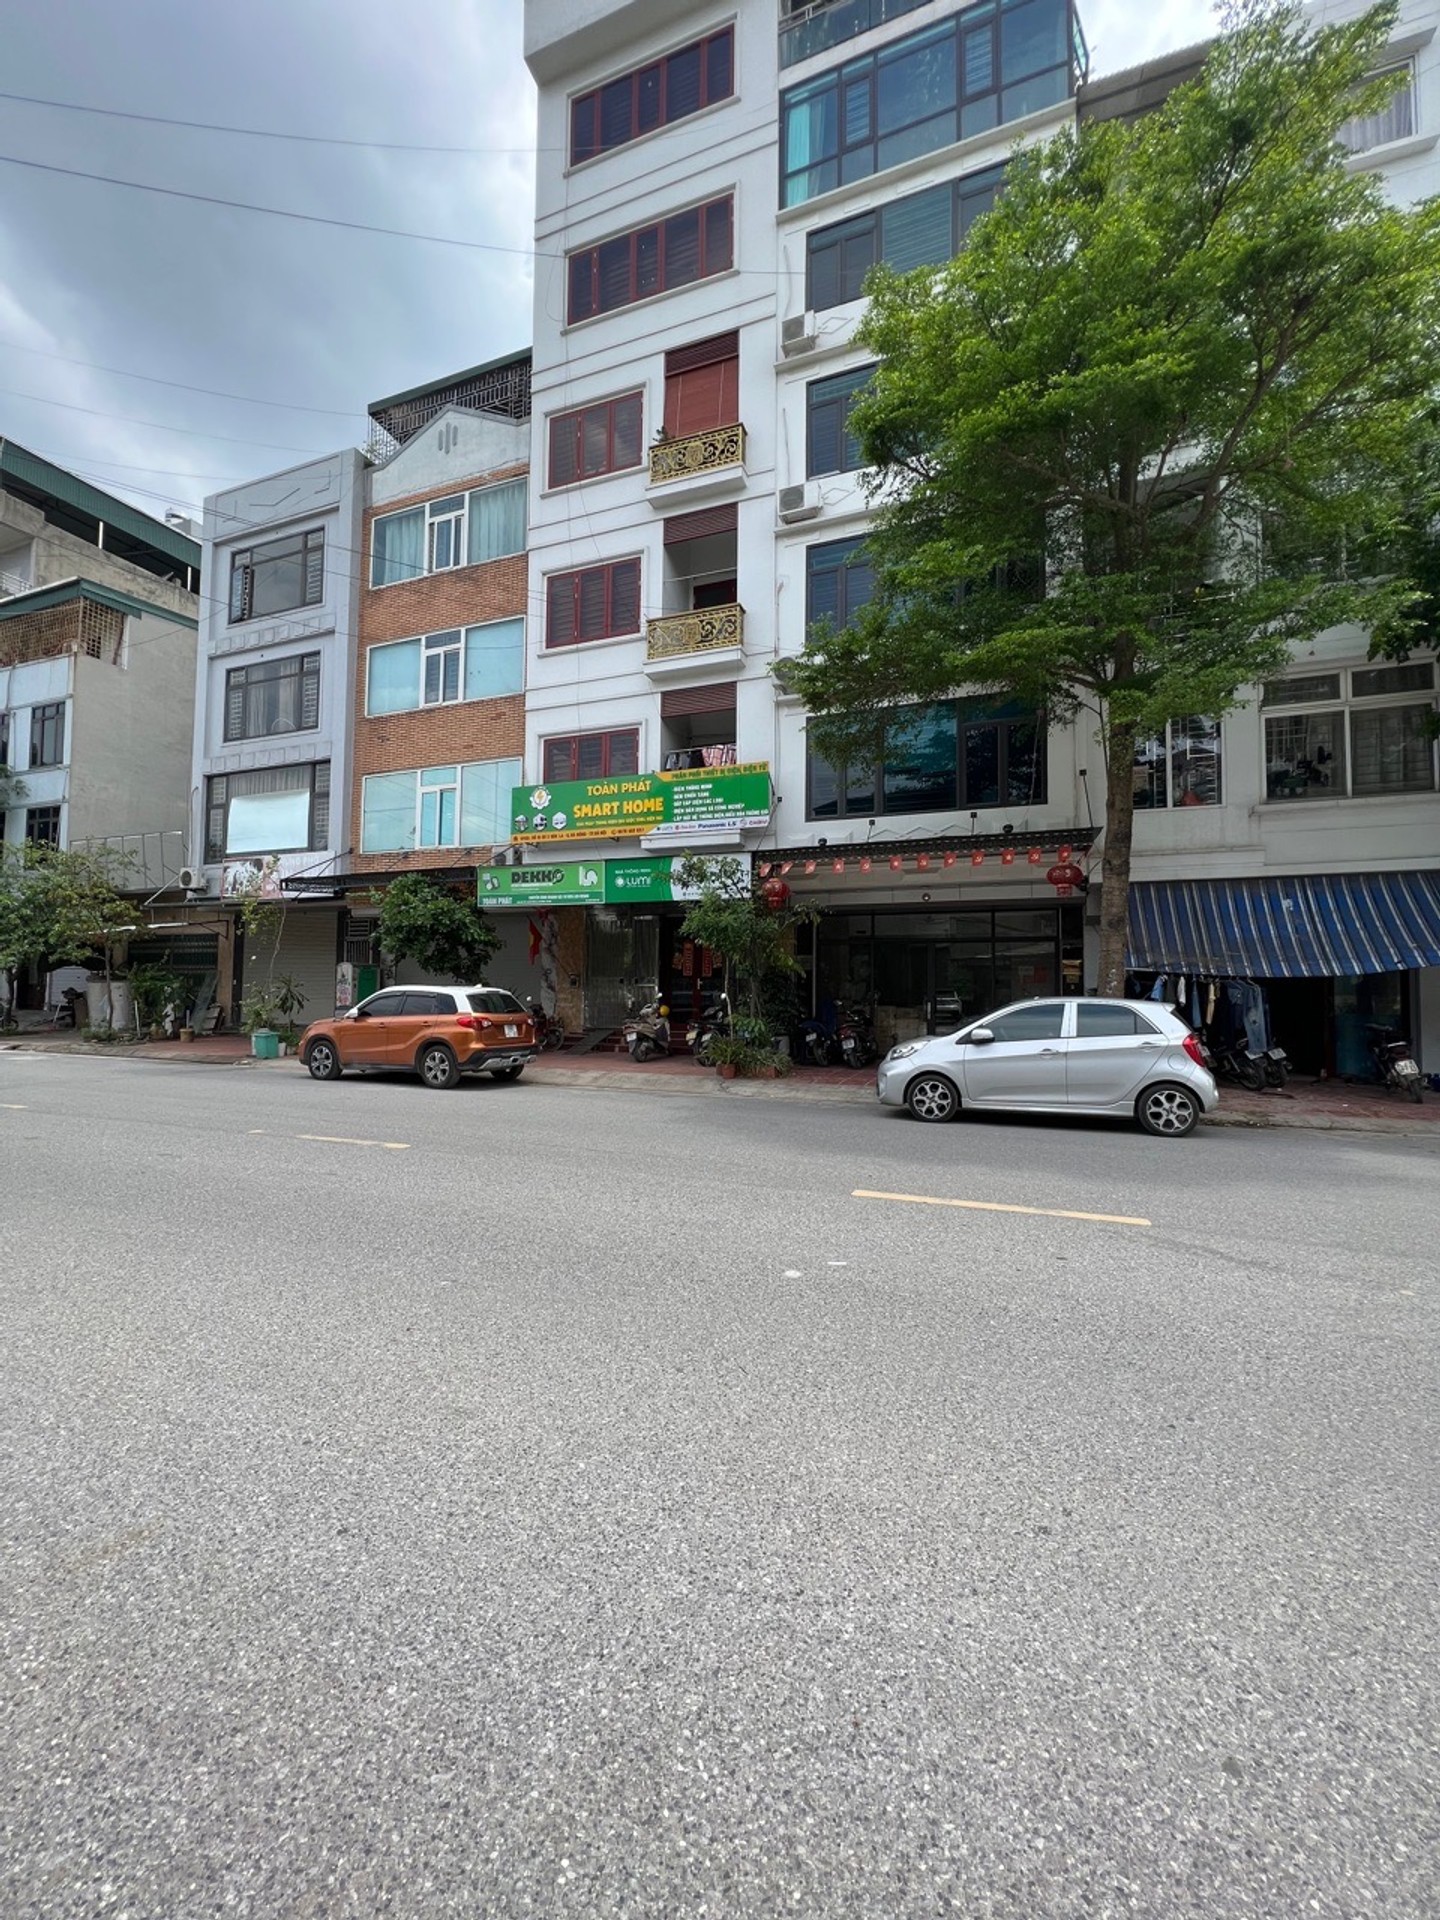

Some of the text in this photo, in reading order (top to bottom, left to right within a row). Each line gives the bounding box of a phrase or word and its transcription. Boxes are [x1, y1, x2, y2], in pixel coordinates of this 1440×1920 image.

[587, 777, 652, 796] TOÀN PHÁT
[573, 797, 664, 818] SMART HOME
